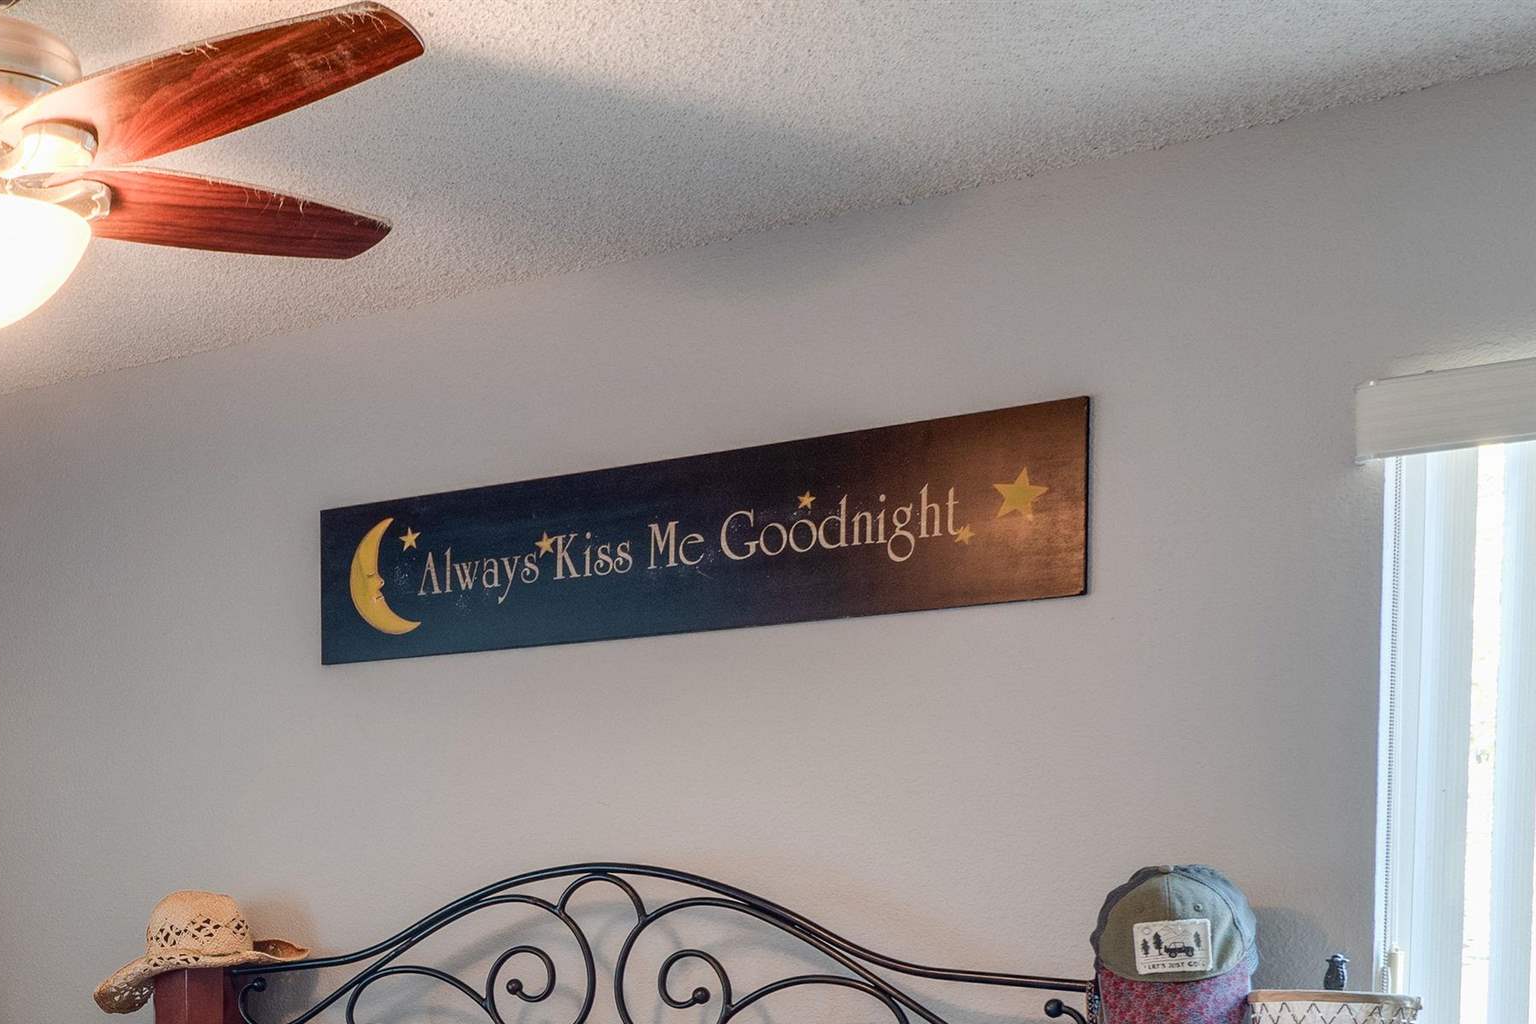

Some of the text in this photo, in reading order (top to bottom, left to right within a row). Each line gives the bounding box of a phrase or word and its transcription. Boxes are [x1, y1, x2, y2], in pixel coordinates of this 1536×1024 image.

[417, 483, 961, 605] Always Kiss Me Goodnight
